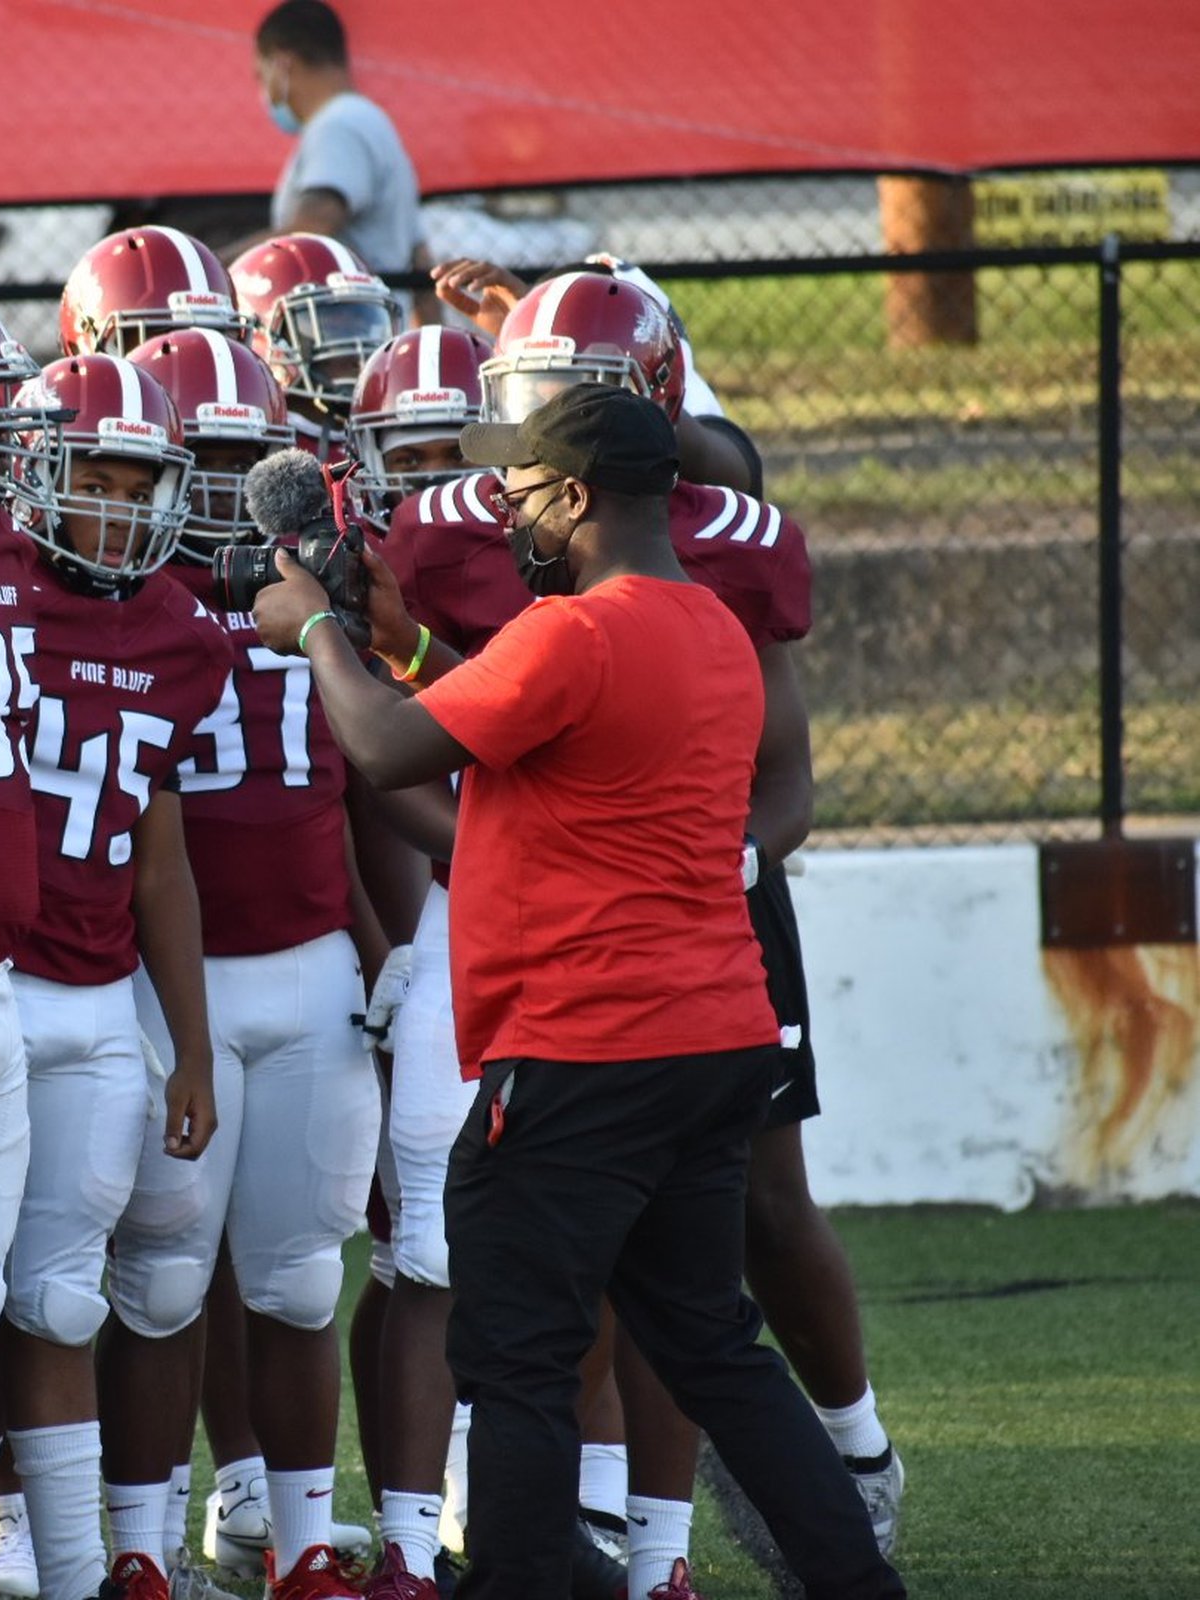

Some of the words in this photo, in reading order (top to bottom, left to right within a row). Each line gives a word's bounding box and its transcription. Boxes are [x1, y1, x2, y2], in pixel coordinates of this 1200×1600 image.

[412, 391, 450, 402] Riddell
[213, 406, 250, 418] Riddell
[116, 421, 152, 436] Riddell
[70, 660, 106, 685] PINE
[112, 666, 155, 695] BLUFF
[29, 696, 175, 866] 45
